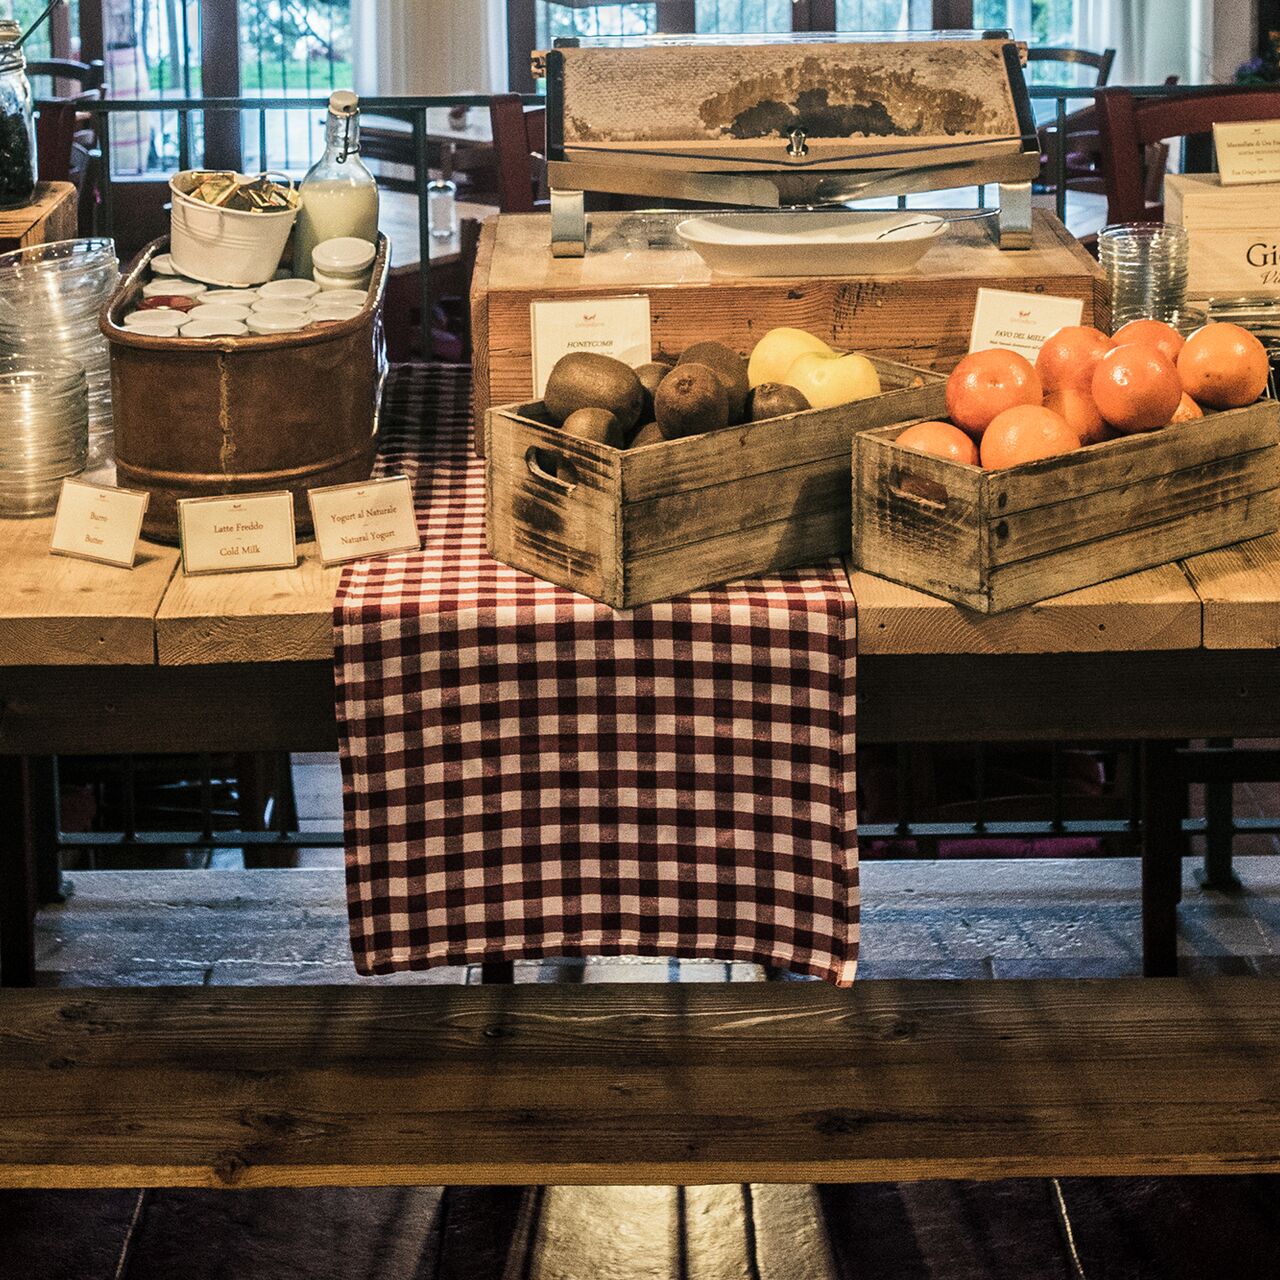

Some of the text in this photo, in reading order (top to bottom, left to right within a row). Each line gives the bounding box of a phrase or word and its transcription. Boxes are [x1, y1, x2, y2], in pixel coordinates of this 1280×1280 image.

[567, 340, 613, 349] HONEYCOMB
[330, 505, 397, 524] Yogurt al Naturale
[214, 521, 264, 534] Latte Freddo
[340, 530, 396, 544] Natural Yogurt
[220, 545, 260, 556] Cold Milk
